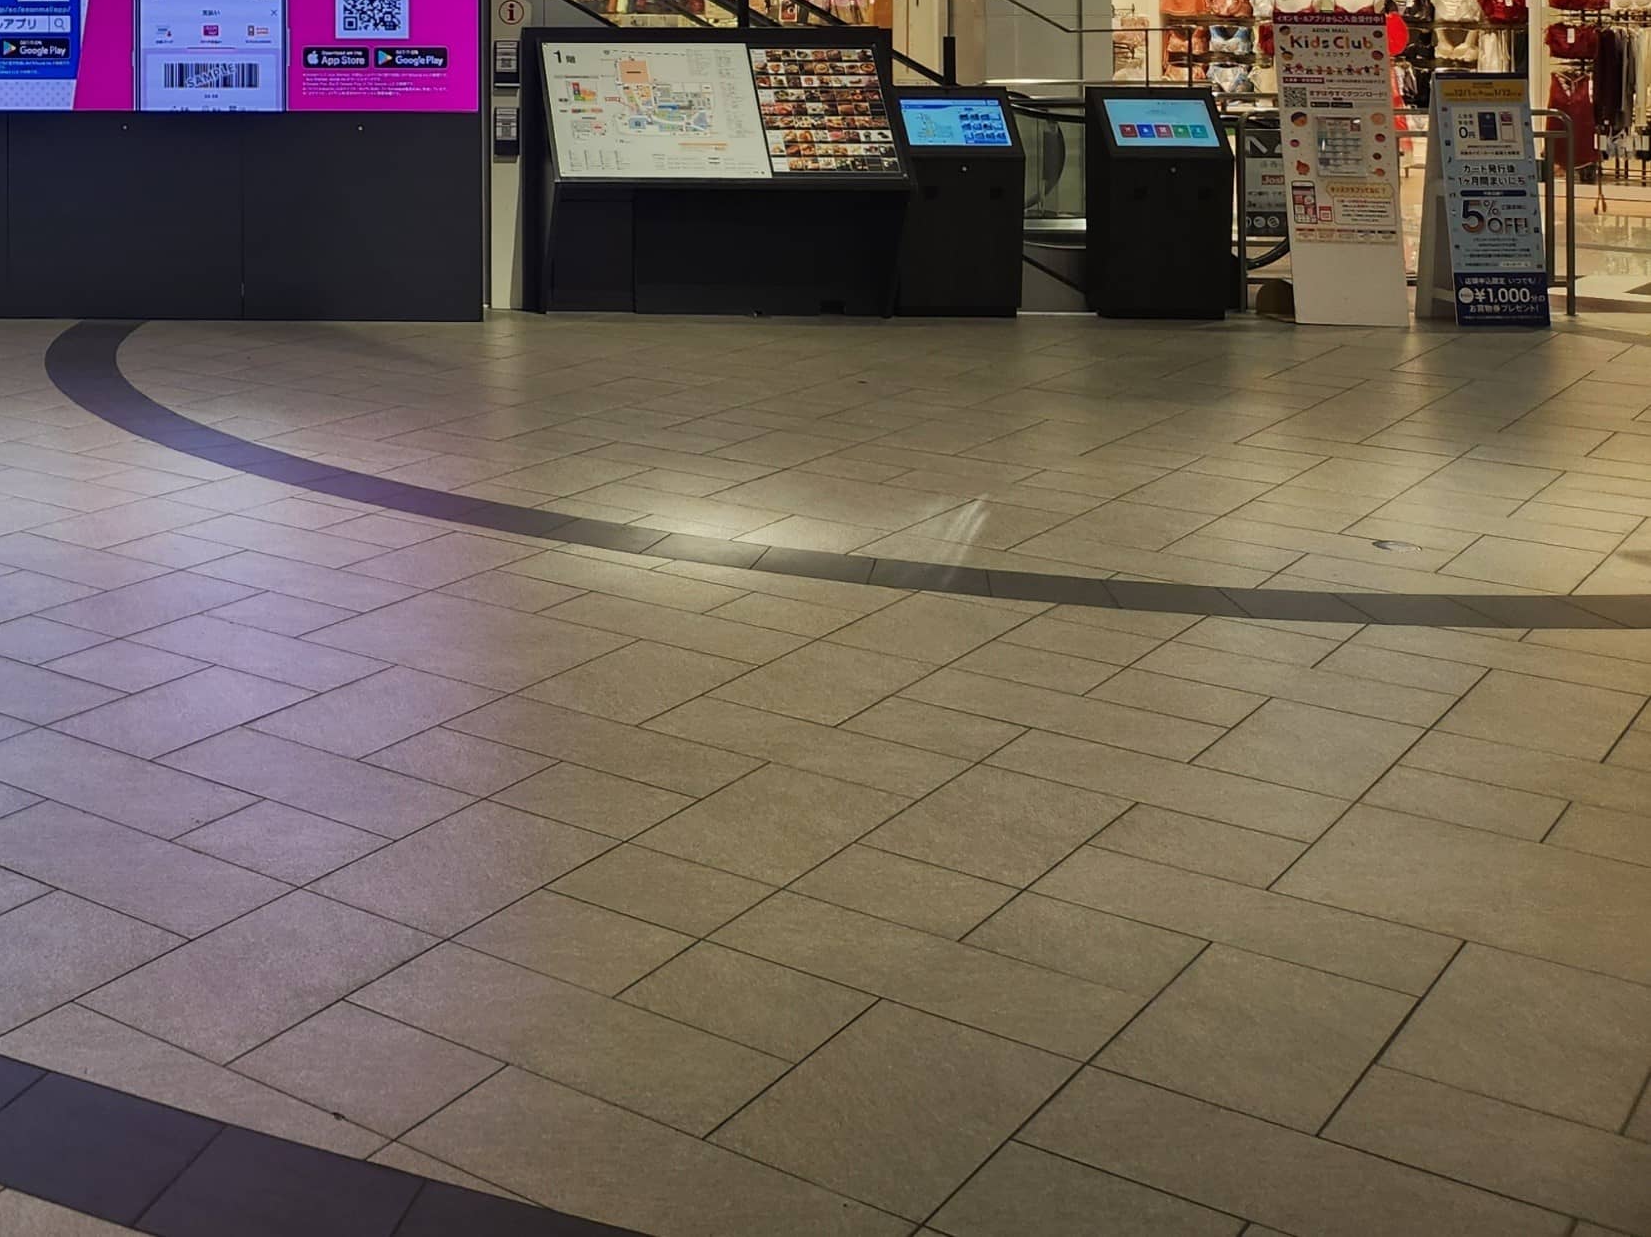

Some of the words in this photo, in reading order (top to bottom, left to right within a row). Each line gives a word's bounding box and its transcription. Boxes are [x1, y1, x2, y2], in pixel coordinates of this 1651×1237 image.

[1290, 35, 1330, 49] Kids
[1333, 35, 1374, 49] Club
[19, 45, 48, 56] Google
[49, 45, 66, 56] Play
[321, 56, 340, 66] App
[341, 55, 365, 65] Store
[395, 55, 425, 66] Google
[426, 55, 443, 66] Play
[186, 63, 237, 89] SAMPLE
